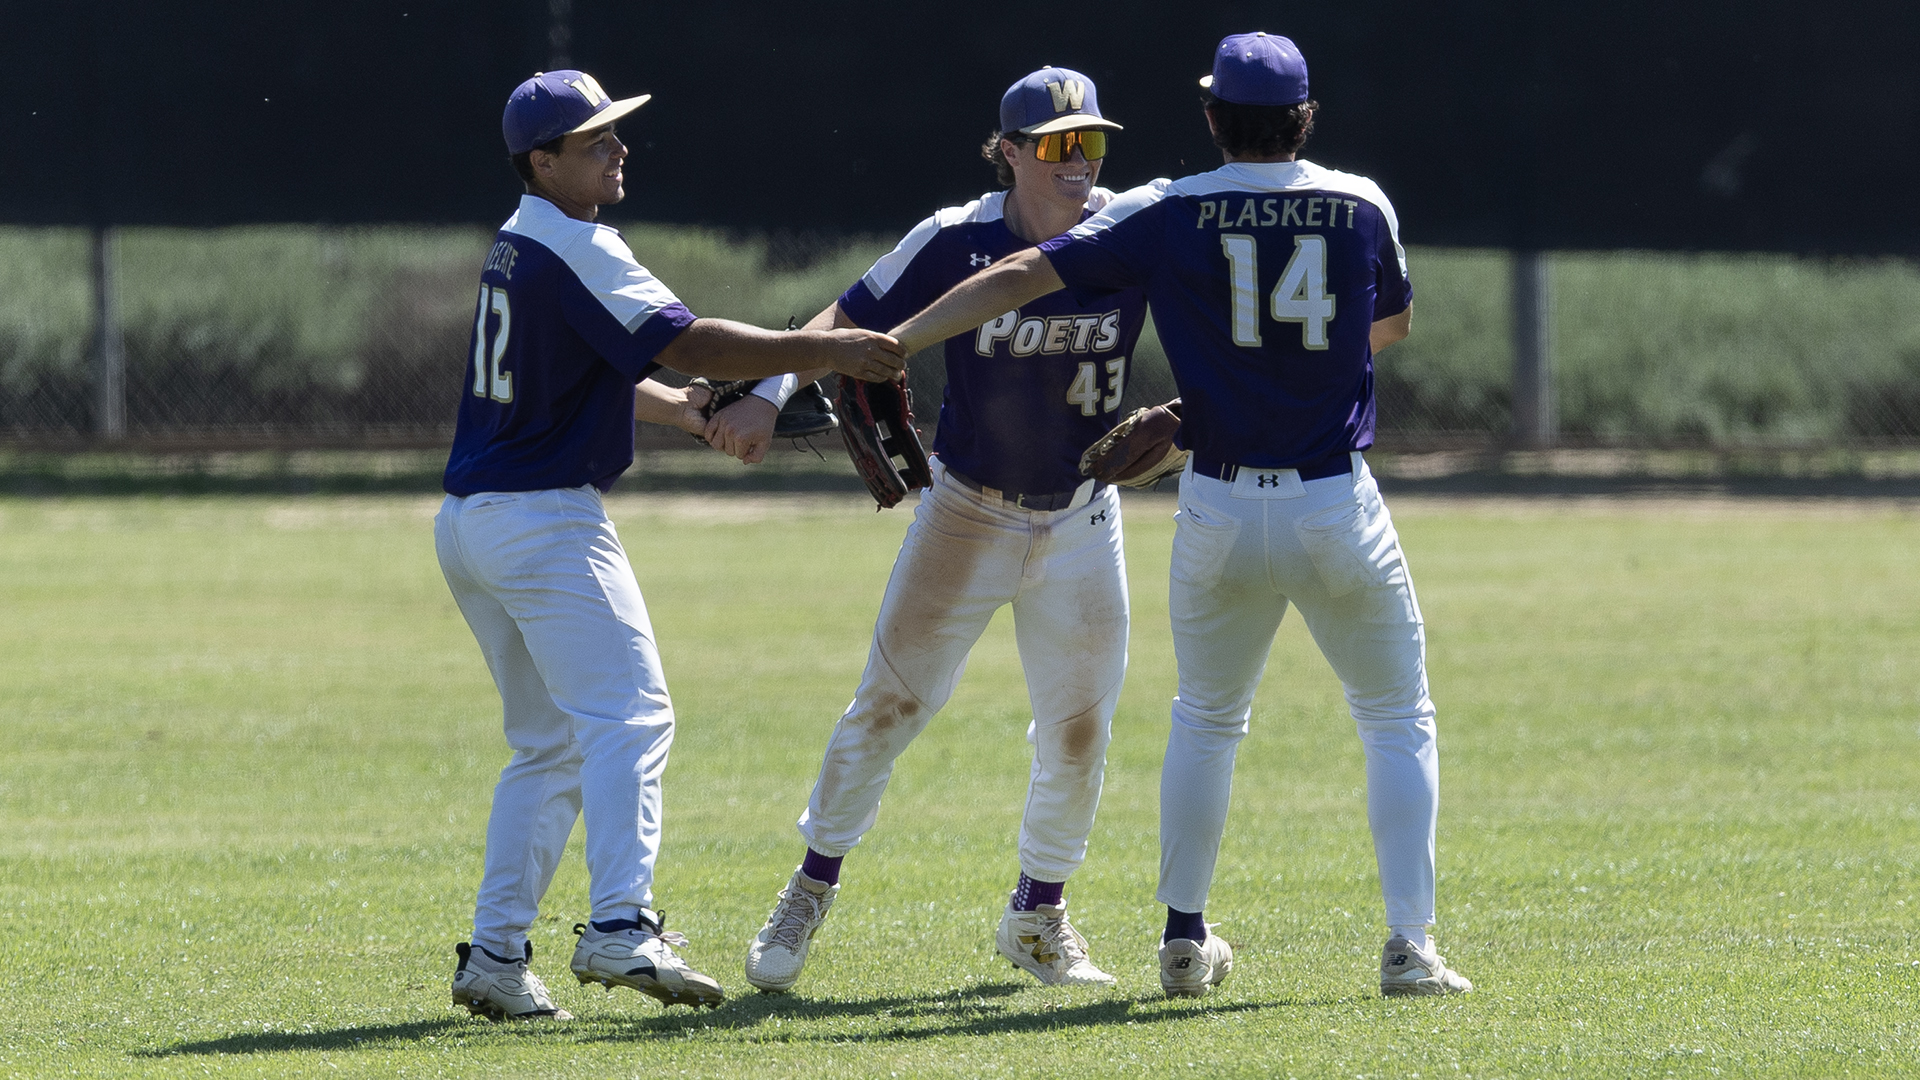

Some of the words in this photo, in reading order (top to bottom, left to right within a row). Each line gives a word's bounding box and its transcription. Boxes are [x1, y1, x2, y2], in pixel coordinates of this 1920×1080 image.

[1047, 79, 1086, 113] W
[1196, 197, 1359, 229] PLASKETT
[1220, 233, 1336, 351] 14
[472, 282, 514, 404] 12
[975, 307, 1121, 358] POETS
[1066, 355, 1127, 417] 43
